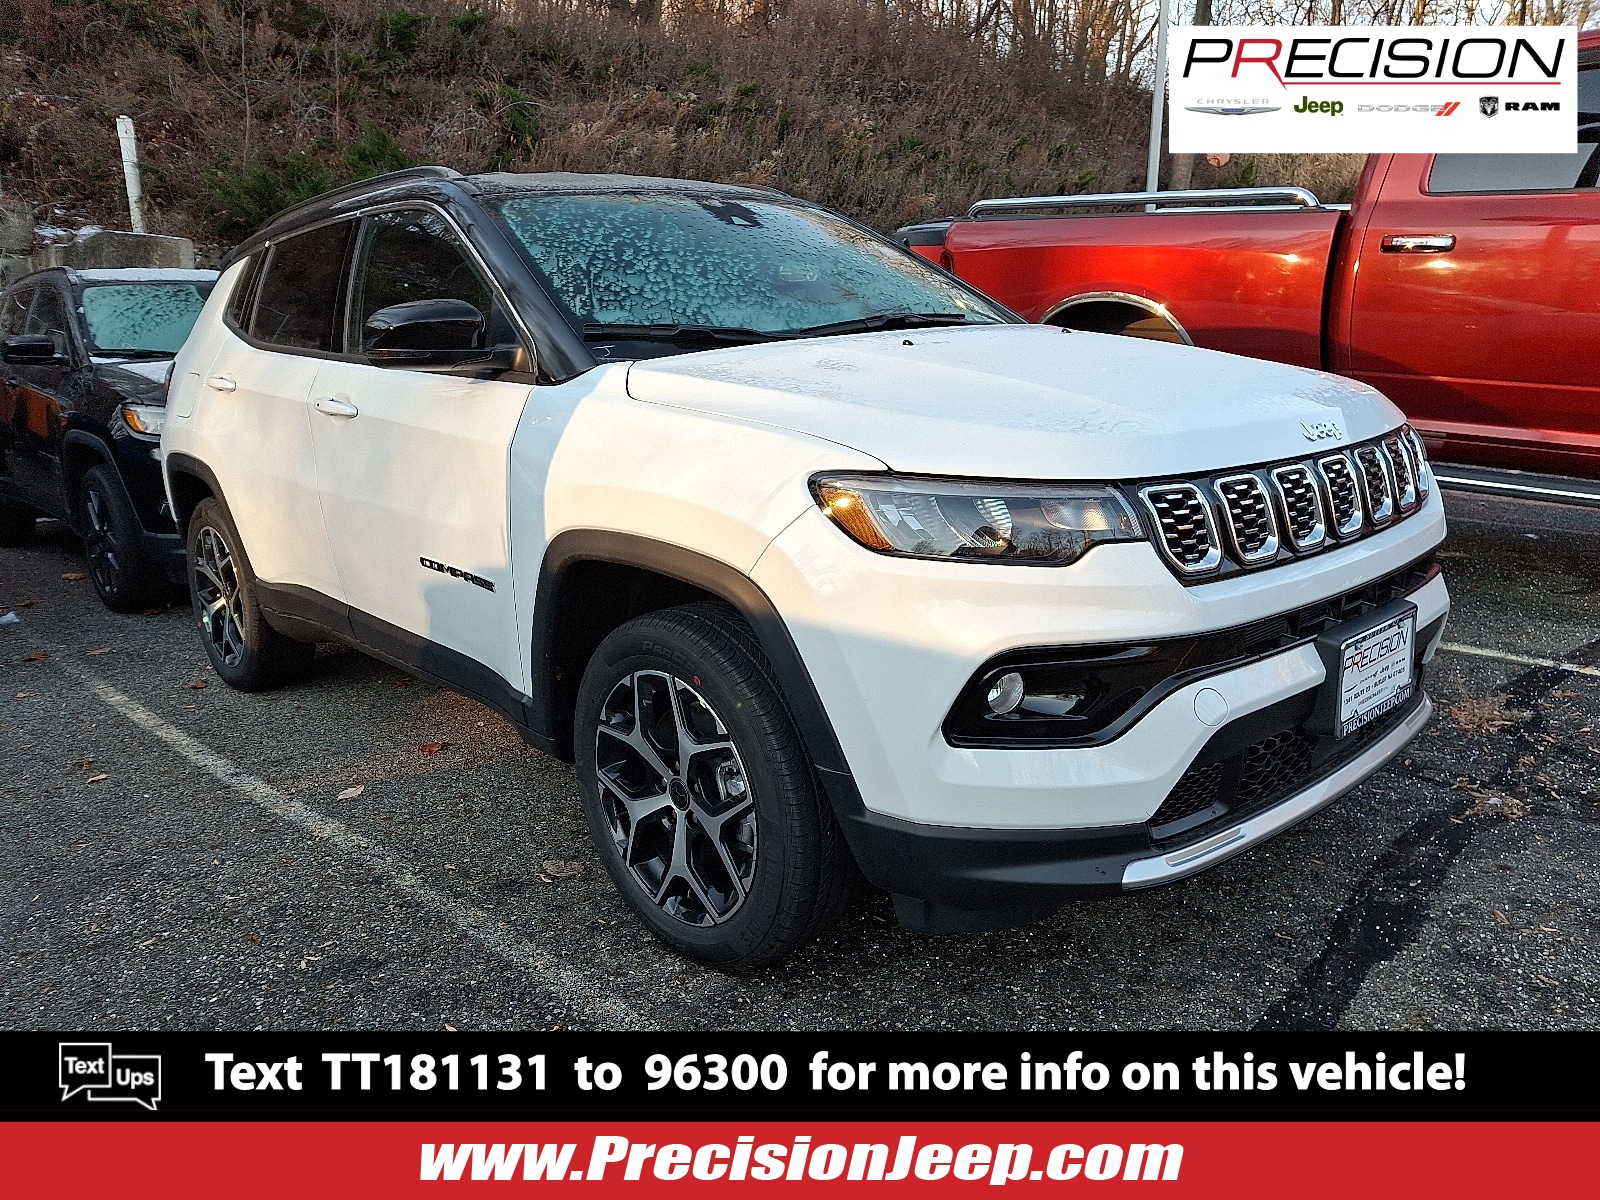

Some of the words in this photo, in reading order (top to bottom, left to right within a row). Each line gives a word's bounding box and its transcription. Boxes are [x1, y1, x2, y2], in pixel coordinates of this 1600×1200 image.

[1299, 419, 1343, 442] Jeep
[1344, 627, 1409, 673] PRECISION
[1343, 687, 1410, 737] PRECISIONJEEP.COM
